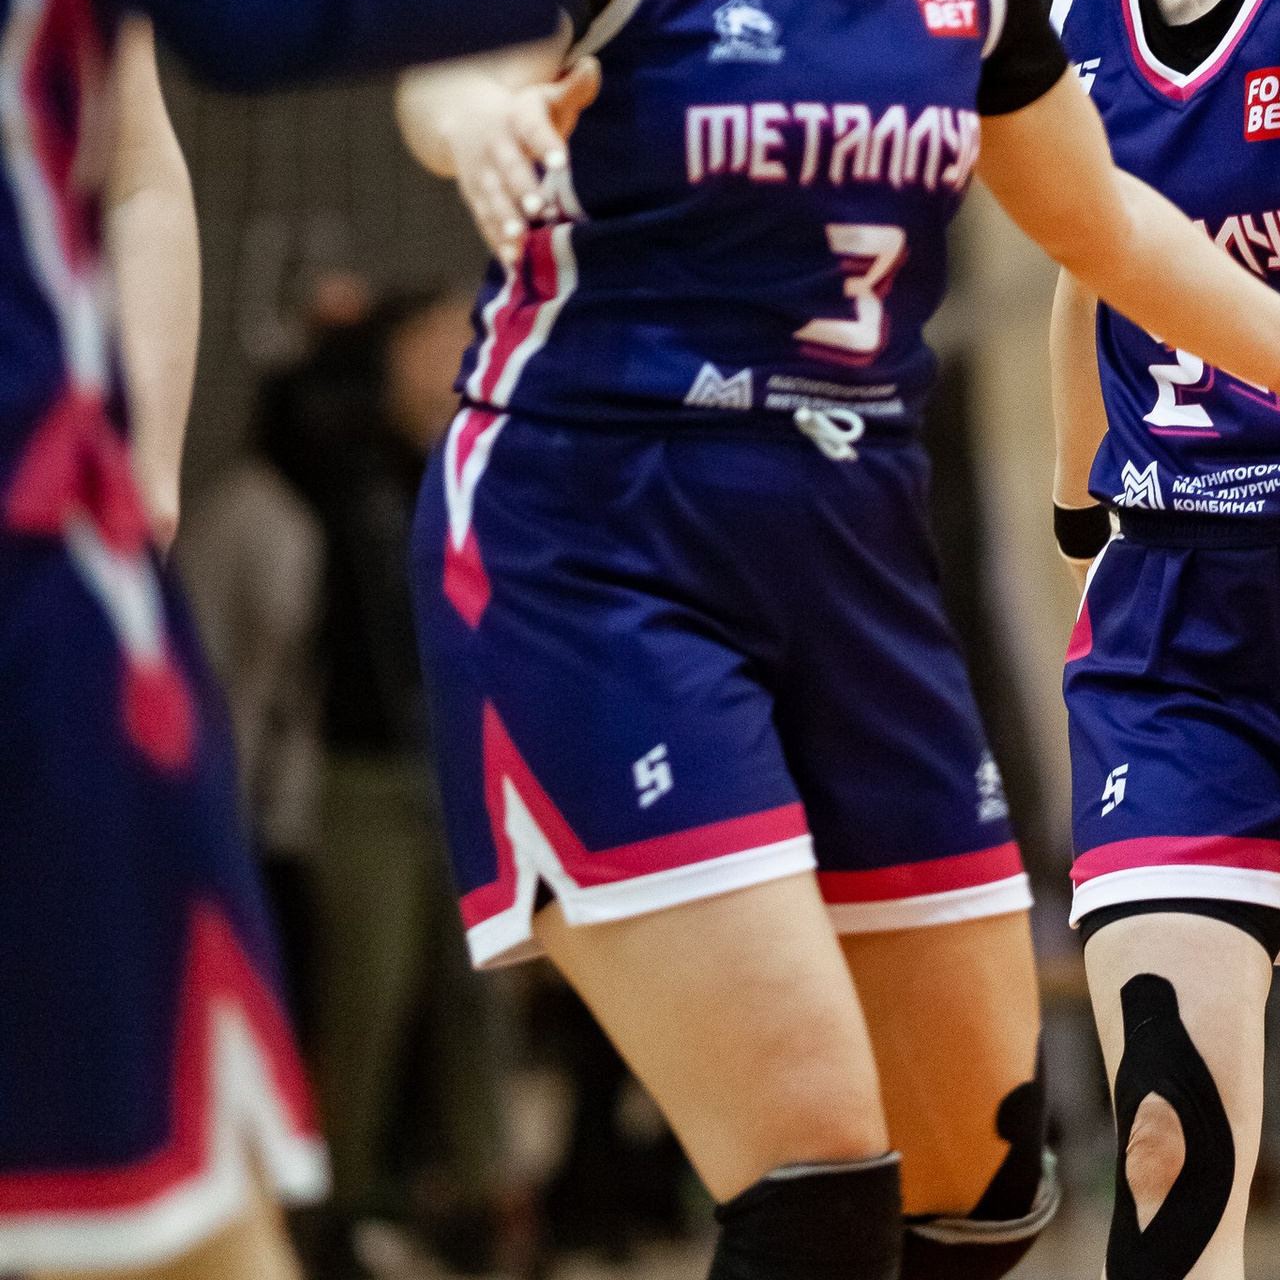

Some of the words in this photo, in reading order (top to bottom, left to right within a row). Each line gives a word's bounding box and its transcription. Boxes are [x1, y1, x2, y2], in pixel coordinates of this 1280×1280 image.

[924, 1, 976, 29] BET
[685, 101, 981, 189] МЕТАЛЛУ
[792, 223, 908, 360] 3
[1173, 498, 1266, 514] КОМБИНАТ
